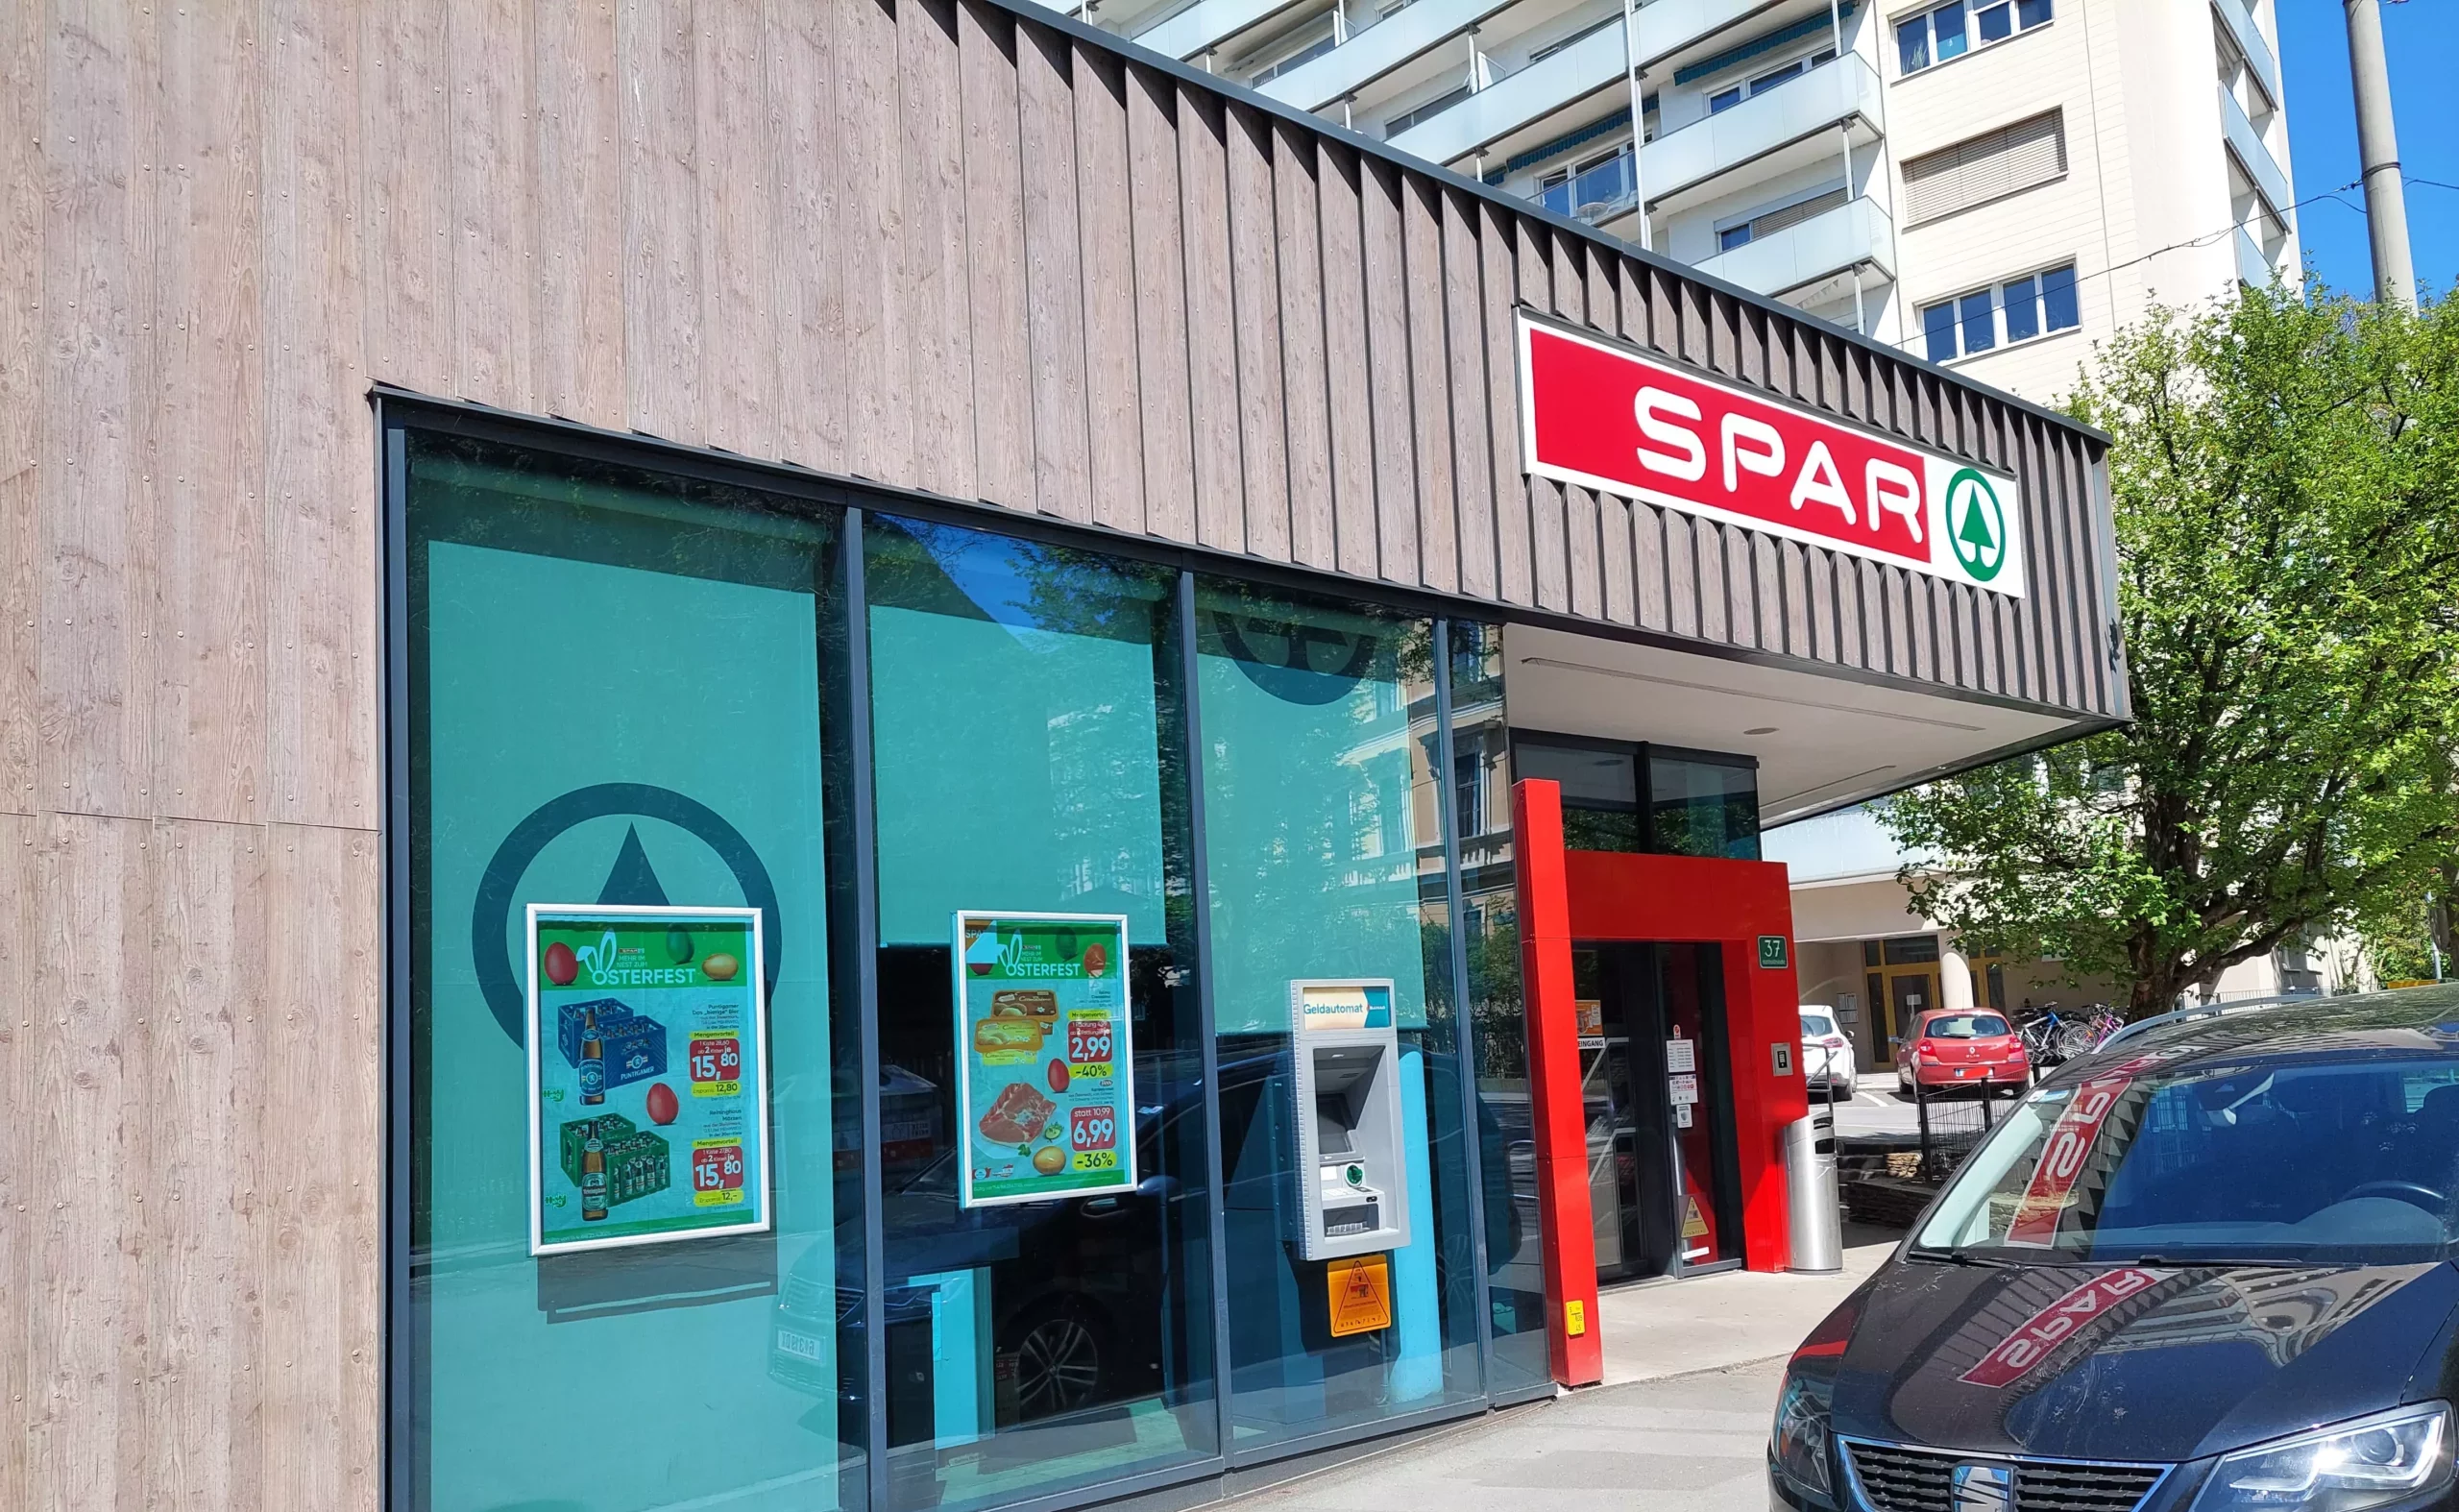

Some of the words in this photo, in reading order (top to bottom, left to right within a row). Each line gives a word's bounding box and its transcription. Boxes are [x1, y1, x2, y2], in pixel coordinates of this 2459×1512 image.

[1634, 385, 1923, 544] SPAR
[1764, 939, 1780, 958] 37
[592, 967, 696, 986] OSTERFEST
[1006, 963, 1081, 977] OSTERFEST
[1303, 1003, 1363, 1014] Geldautomat
[724, 1045, 732, 1055] je
[1071, 1036, 1111, 1061] 2,99
[1577, 1039, 1604, 1048] EINGANG
[620, 1065, 655, 1081] PUNTIGAMER
[1075, 1064, 1108, 1077] -40%
[715, 1083, 738, 1093] 12,80
[1074, 1109, 1091, 1117] statt
[1093, 1107, 1110, 1117] 10,99
[1073, 1118, 1114, 1148] 6,99
[696, 1137, 738, 1146] Mengenvorteil
[727, 1153, 735, 1161] je
[1076, 1152, 1113, 1168] -36%
